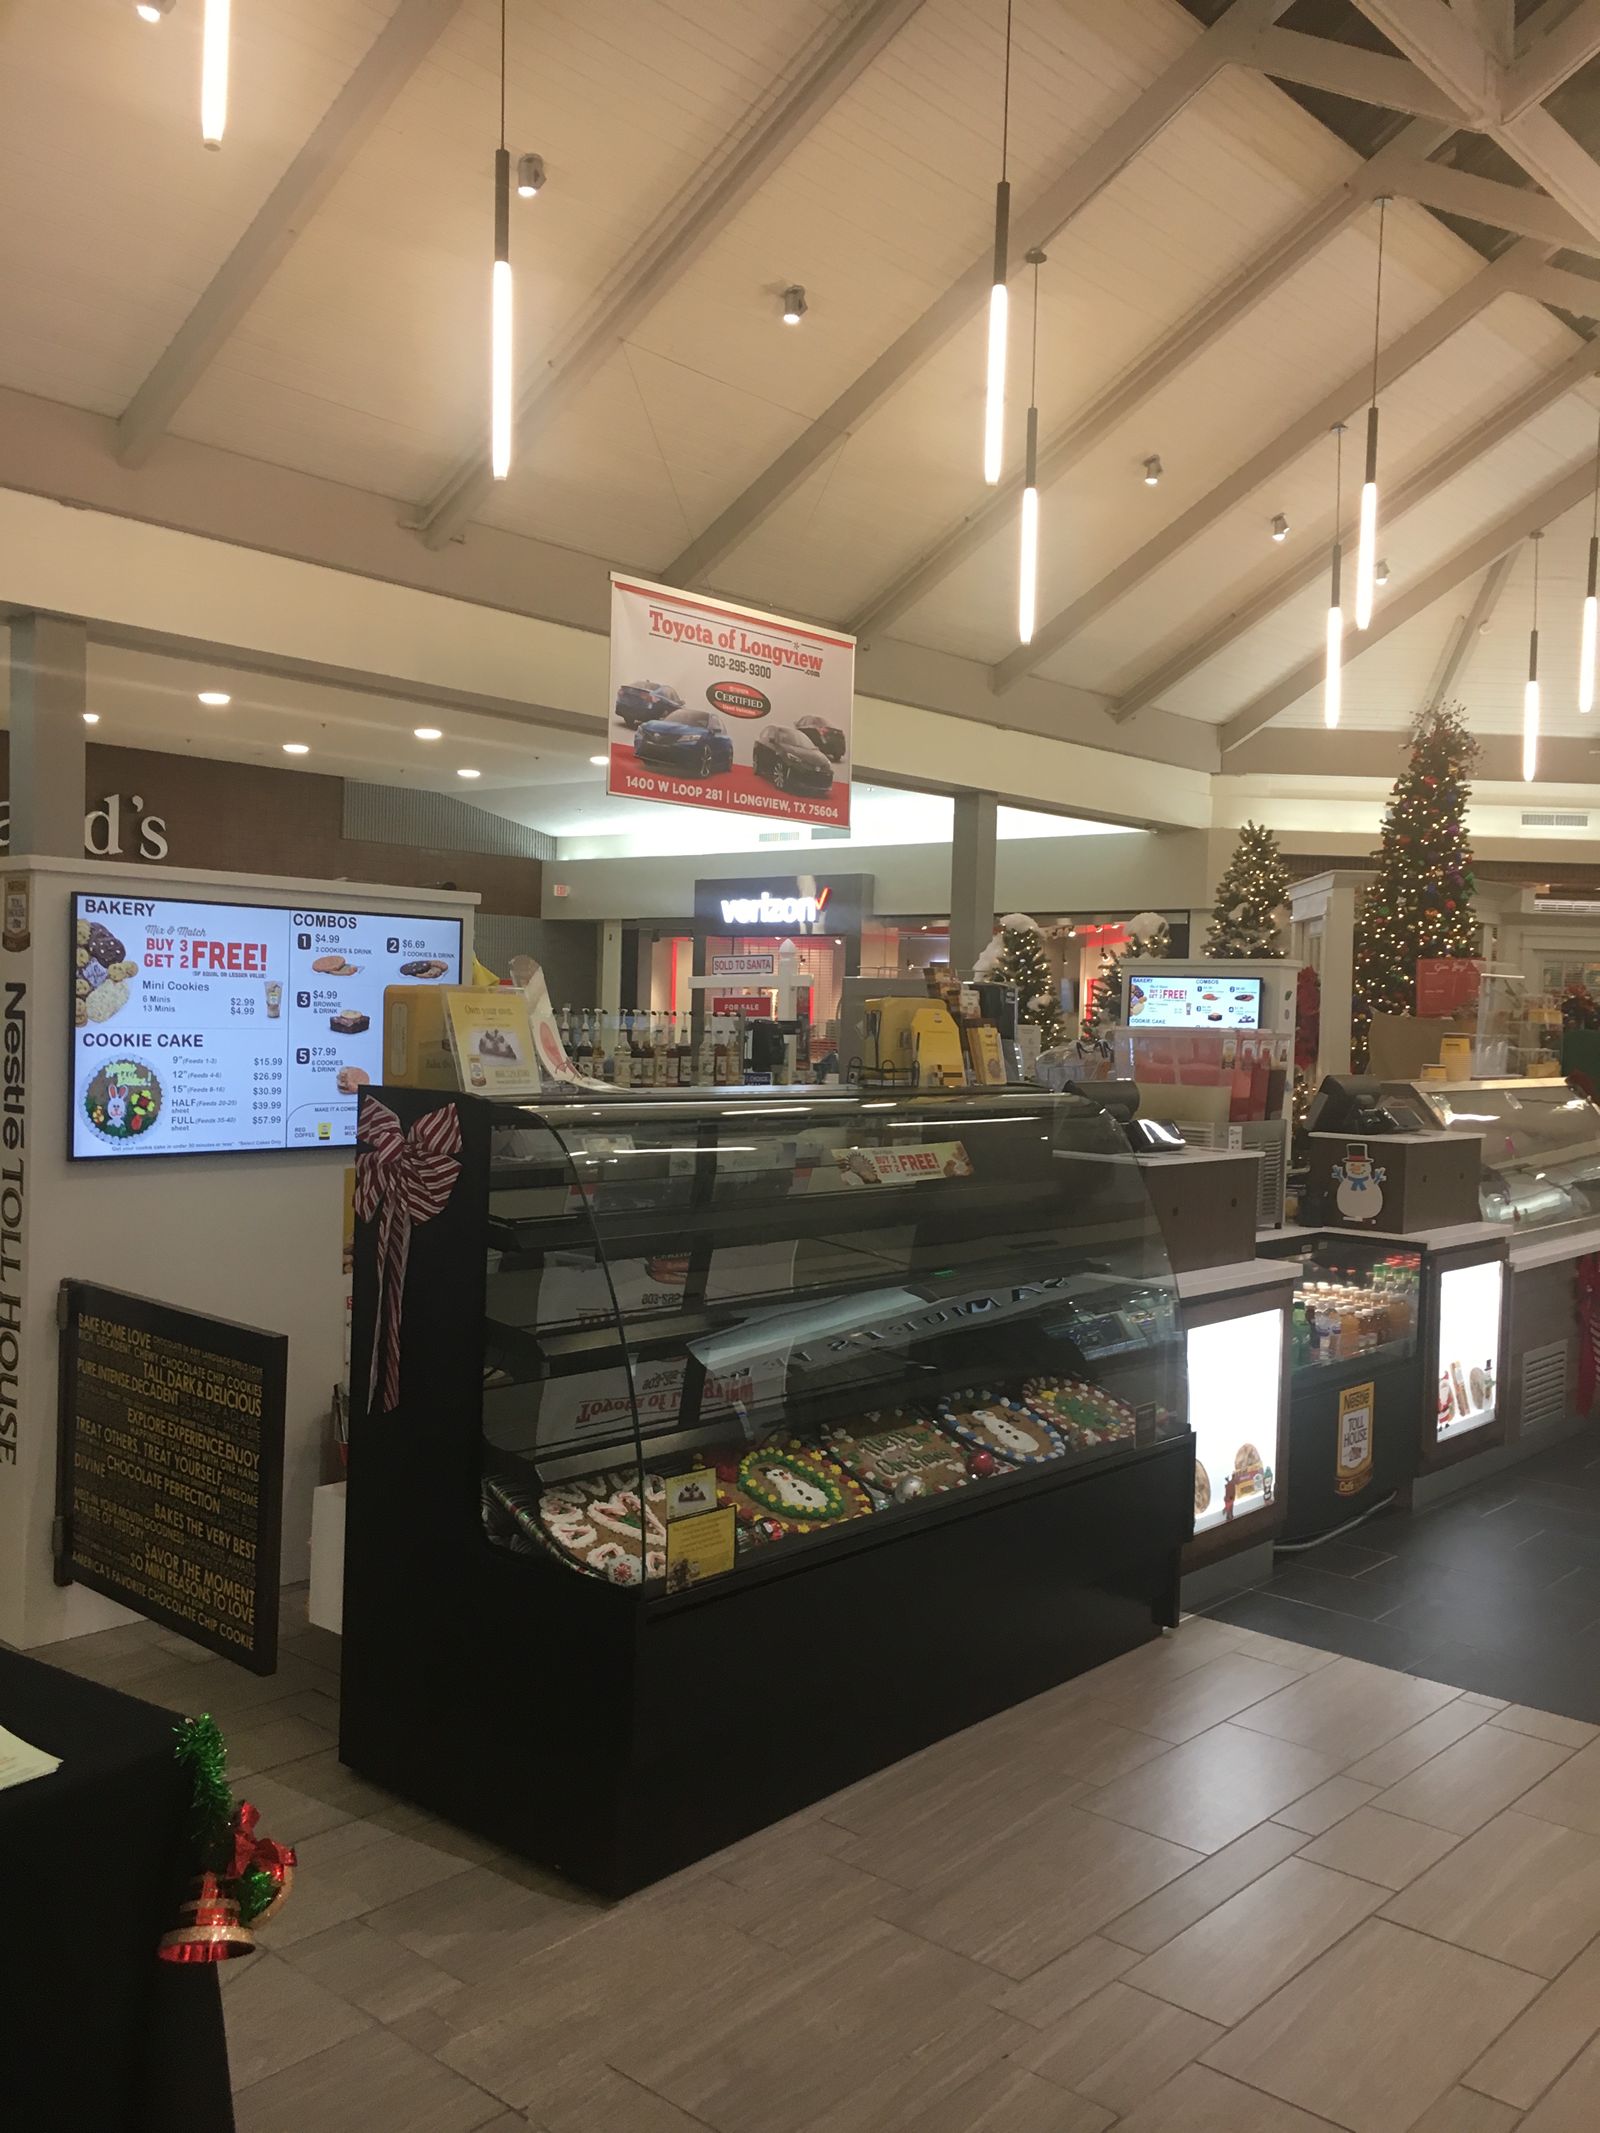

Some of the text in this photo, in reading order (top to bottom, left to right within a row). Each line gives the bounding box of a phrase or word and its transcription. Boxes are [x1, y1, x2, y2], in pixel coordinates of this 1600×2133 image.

[649, 610, 824, 671] Toyota of Longview
[708, 653, 772, 679] 903-295-9300
[714, 690, 763, 709] CERTIFIED
[625, 775, 838, 819] 1400 W LOOP 281 LONGVIEW, TX 75604
[85, 899, 156, 917] BAKERY
[720, 891, 817, 924] verizon
[293, 913, 357, 929] COMBOS
[177, 926, 207, 938] Match
[315, 933, 340, 944] $4.99
[146, 938, 188, 952] BUY 3
[402, 938, 426, 949] $6.69
[144, 940, 267, 971] GET 2 FREE!
[714, 958, 771, 971] SOLD TO SANTA
[143, 981, 210, 992] Mini Cookies
[313, 989, 338, 1000] $4.99
[1163, 989, 1187, 1000] FREE!
[230, 997, 255, 1006] $2.99
[154, 1005, 176, 1013] Minis
[230, 1007, 255, 1016] $4.99
[83, 1033, 204, 1048] COOKIE CAKE
[311, 1047, 337, 1057] $7.99
[254, 1057, 283, 1066] $15.99
[253, 1072, 282, 1081] $26.99
[252, 1087, 282, 1096] $30.99
[172, 1099, 196, 1107] HALF
[252, 1101, 282, 1110] $39.99
[171, 1116, 194, 1125] FULL
[252, 1116, 282, 1125] $57.99
[1, 1157, 24, 1284] TOLL
[79, 1313, 151, 1350] BAKE SOME LOVE
[160, 1354, 262, 1398] CHOCOLATE CHIP COOKIES
[168, 1370, 196, 1395] DARK
[196, 1381, 204, 1398] &
[206, 1382, 261, 1417] DELICIOUS
[1348, 1415, 1364, 1431] TOLL
[1343, 1427, 1368, 1448] HOUSE
[77, 1416, 102, 1439] TREAT
[143, 1442, 171, 1467] TREAT
[174, 1453, 222, 1486] YOURSELF
[75, 1452, 106, 1478] DIVINE
[107, 1455, 162, 1490] CHOCOLATE
[164, 1478, 220, 1514] PERFECTION
[144, 1516, 185, 1546] GOODNESS
[154, 1502, 184, 1530] BAKES
[186, 1516, 204, 1539] THE
[205, 1524, 231, 1550] VERY
[232, 1536, 256, 1560] BEST
[145, 1542, 179, 1573] SAVOR
[182, 1558, 201, 1583] THE
[203, 1569, 255, 1608] MOMENT
[131, 1551, 255, 1626] SO MINI REASONS TO LOVE
[148, 1587, 197, 1622] CHOCOLATE
[198, 1612, 218, 1633] CHIP
[220, 1623, 254, 1651] COOKIE
